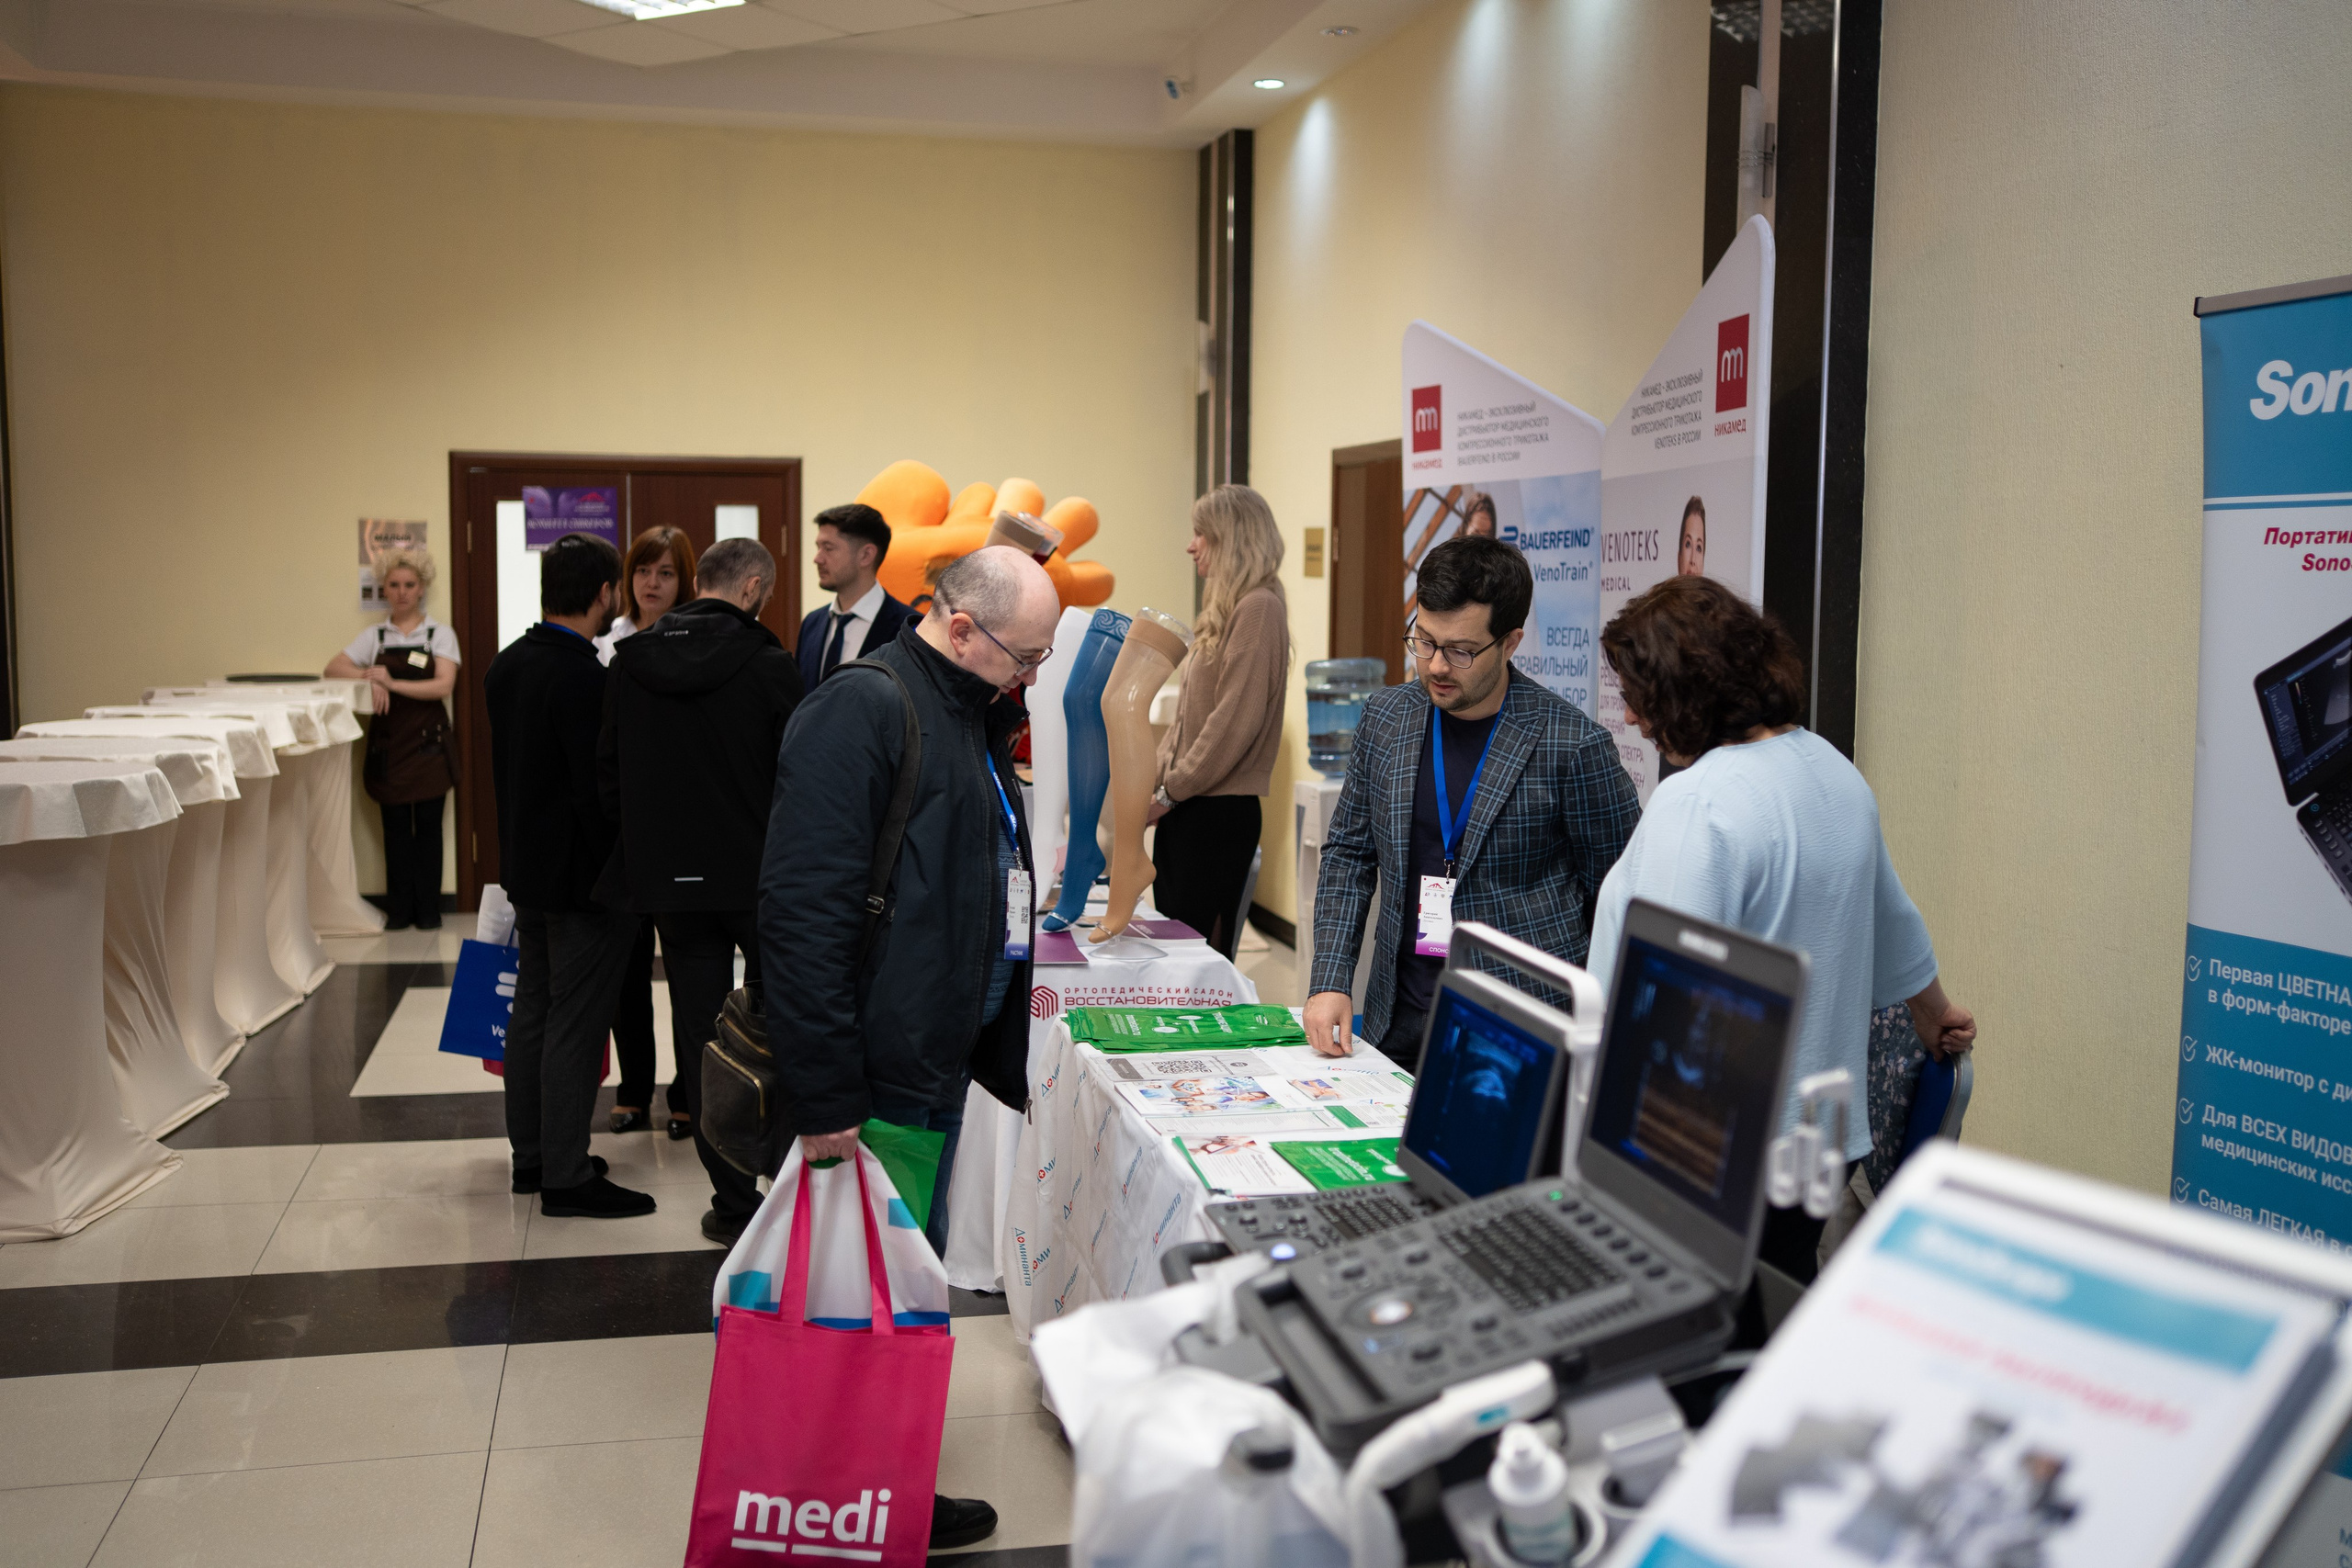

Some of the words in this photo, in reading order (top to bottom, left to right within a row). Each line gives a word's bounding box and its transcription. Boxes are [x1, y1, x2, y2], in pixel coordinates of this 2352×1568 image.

[1714, 419, 1747, 436] никамед
[1600, 529, 1659, 563] VENOTEKS
[1600, 576, 1631, 592] MEDICAL
[1547, 626, 1589, 649] ВСЕГДА
[1429, 946, 1450, 954] СПОНС
[1193, 987, 1232, 998] САЛОН
[2210, 958, 2274, 988] Первая
[2278, 972, 2352, 1007] ЦВЕТНА
[2208, 989, 2218, 1003] в
[2222, 988, 2351, 1036] форм-факторе
[2206, 1044, 2314, 1093] ЖК-монитор
[2318, 1078, 2329, 1094] с
[2201, 1134, 2317, 1182] медицинских
[2202, 1104, 2236, 1129] Для
[2241, 1114, 2288, 1145] ВСЕХ
[2290, 1129, 2352, 1166] ВИДОВ
[2198, 1189, 2252, 1222] Самая
[2257, 1208, 2325, 1250] ЛЕГКАЯ
[733, 1488, 891, 1545] medi
